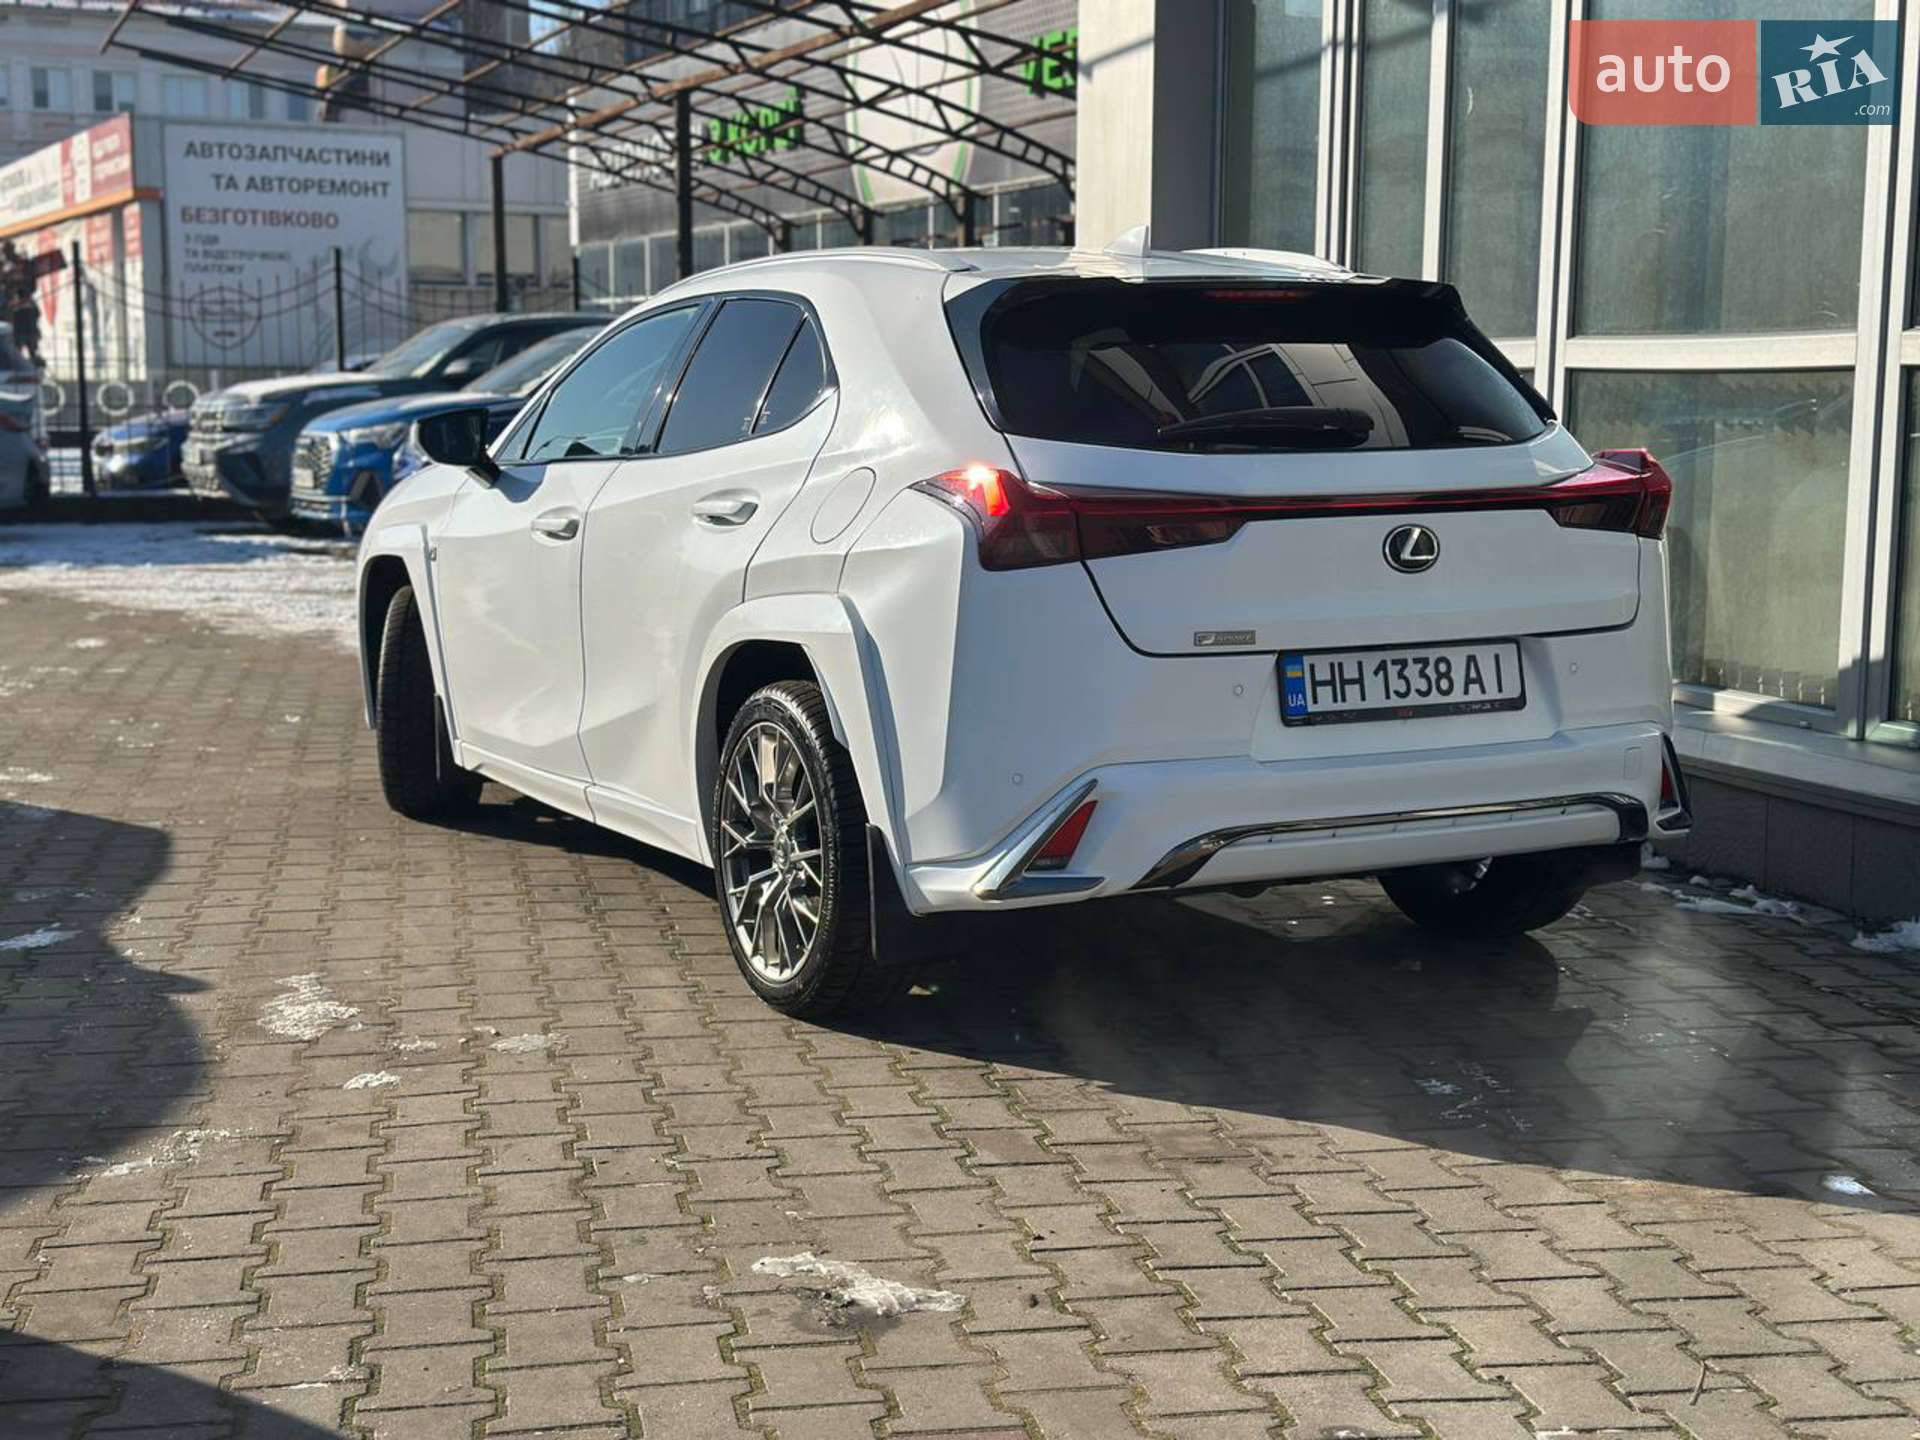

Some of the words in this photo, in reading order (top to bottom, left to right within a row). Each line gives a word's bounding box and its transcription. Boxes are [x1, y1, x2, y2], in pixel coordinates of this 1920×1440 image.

[184, 140, 391, 168] АВТОЗАПЧАСТИНИ
[211, 173, 239, 192] ТА
[245, 175, 391, 198] АВТОРЕМОНТ
[180, 206, 339, 229] БЕЗГОТІВКОВО
[1373, 656, 1455, 700] 1338
[1288, 693, 1306, 707] UA
